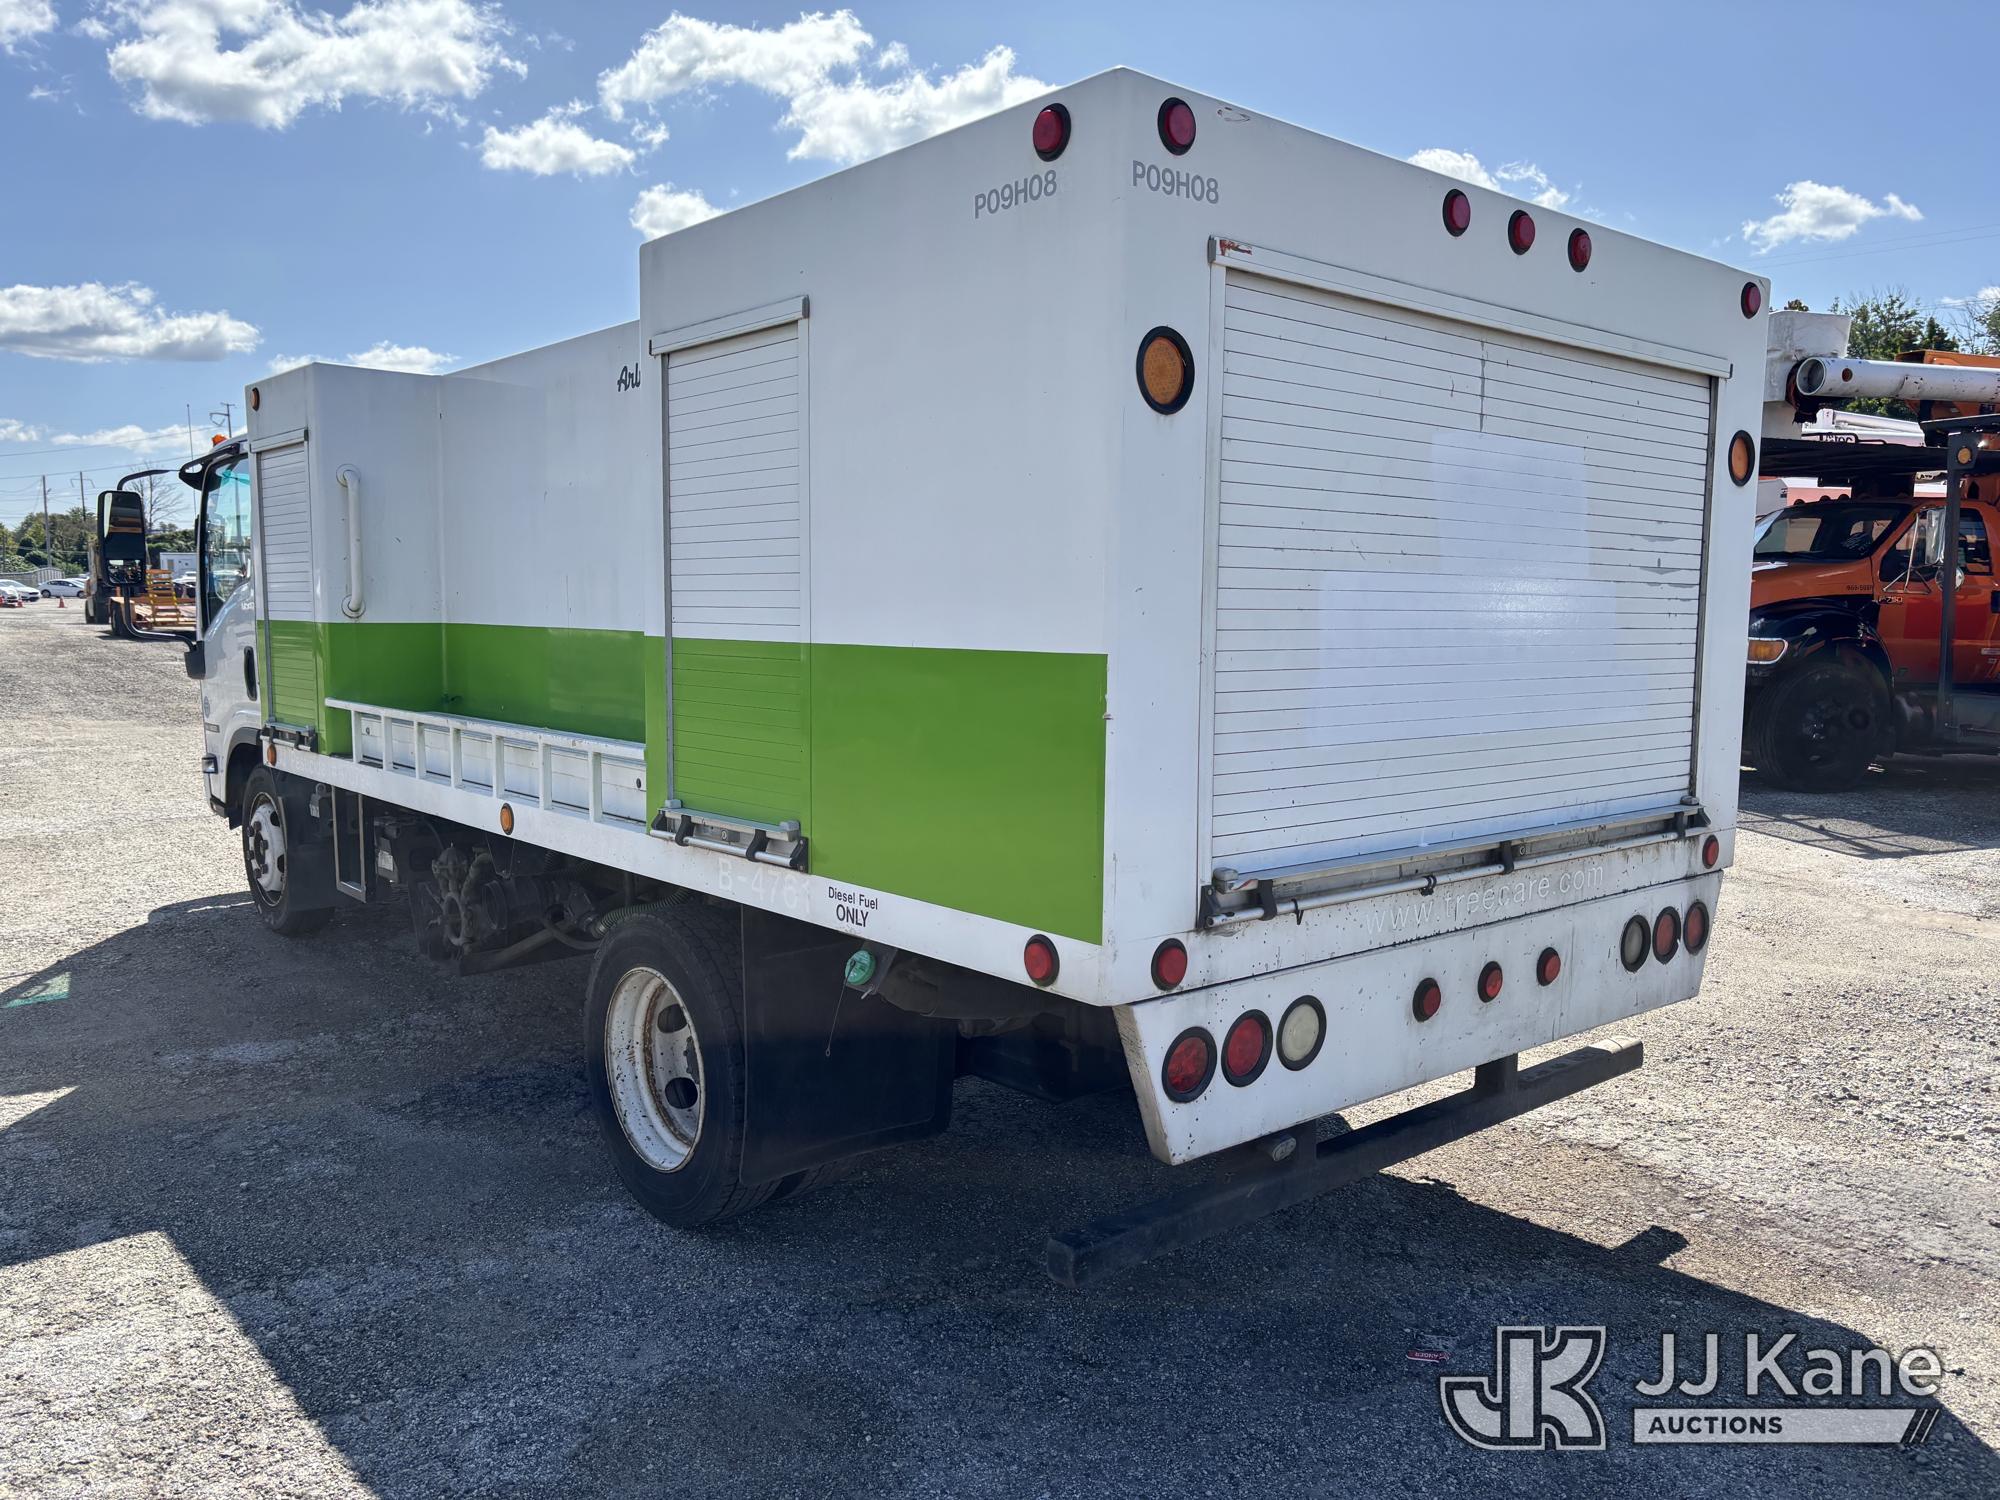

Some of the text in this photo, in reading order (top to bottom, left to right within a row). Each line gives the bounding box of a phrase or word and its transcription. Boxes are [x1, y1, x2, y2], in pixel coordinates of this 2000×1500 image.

[975, 170, 1057, 218] P09H08
[1133, 160, 1219, 204] P09H08
[828, 886, 879, 910] Diesel Fuel
[836, 904, 869, 928] ONLY
[1365, 866, 1604, 935] www.treecare.com
